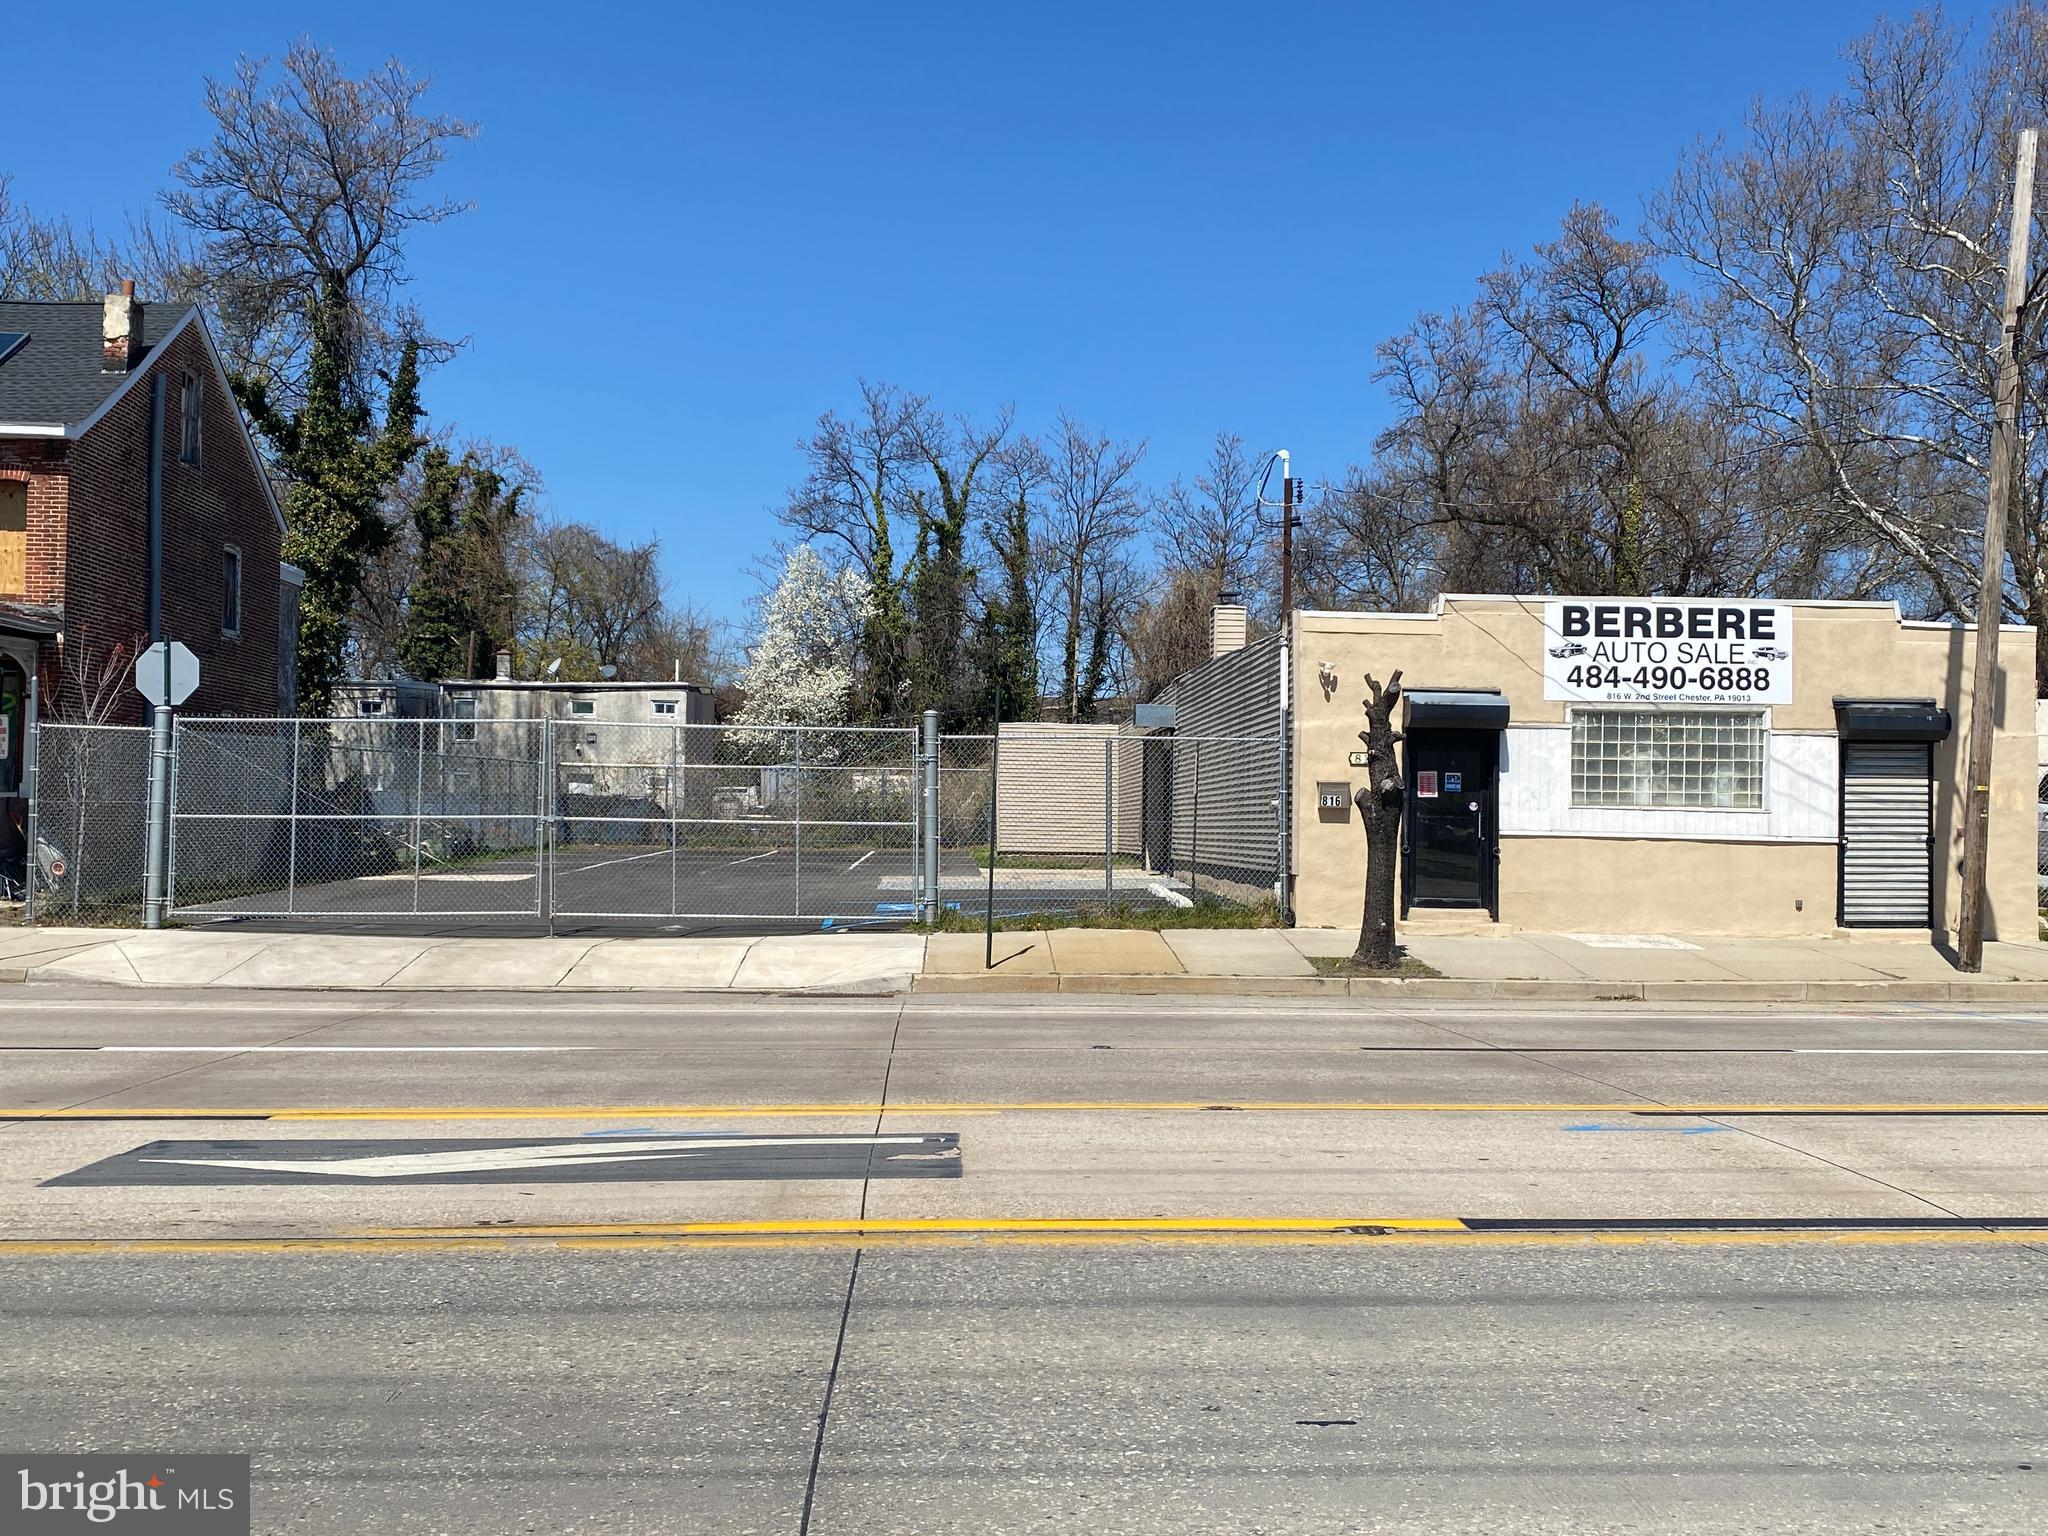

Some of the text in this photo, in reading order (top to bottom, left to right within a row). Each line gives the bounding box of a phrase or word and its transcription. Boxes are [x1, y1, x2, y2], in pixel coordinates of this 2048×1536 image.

[1562, 605, 1776, 640] BERBERE
[1592, 641, 1668, 664] AUTO
[1677, 642, 1745, 665] SALE
[1567, 664, 1770, 692] 484-490-6888
[1606, 692, 1622, 700] 816
[1635, 693, 1651, 701] 2nd
[1653, 693, 1677, 701] Street
[1679, 693, 1712, 703] Chester,
[1714, 694, 1726, 702] PA
[1728, 694, 1751, 702] 19013
[1322, 795, 1341, 807] 816
